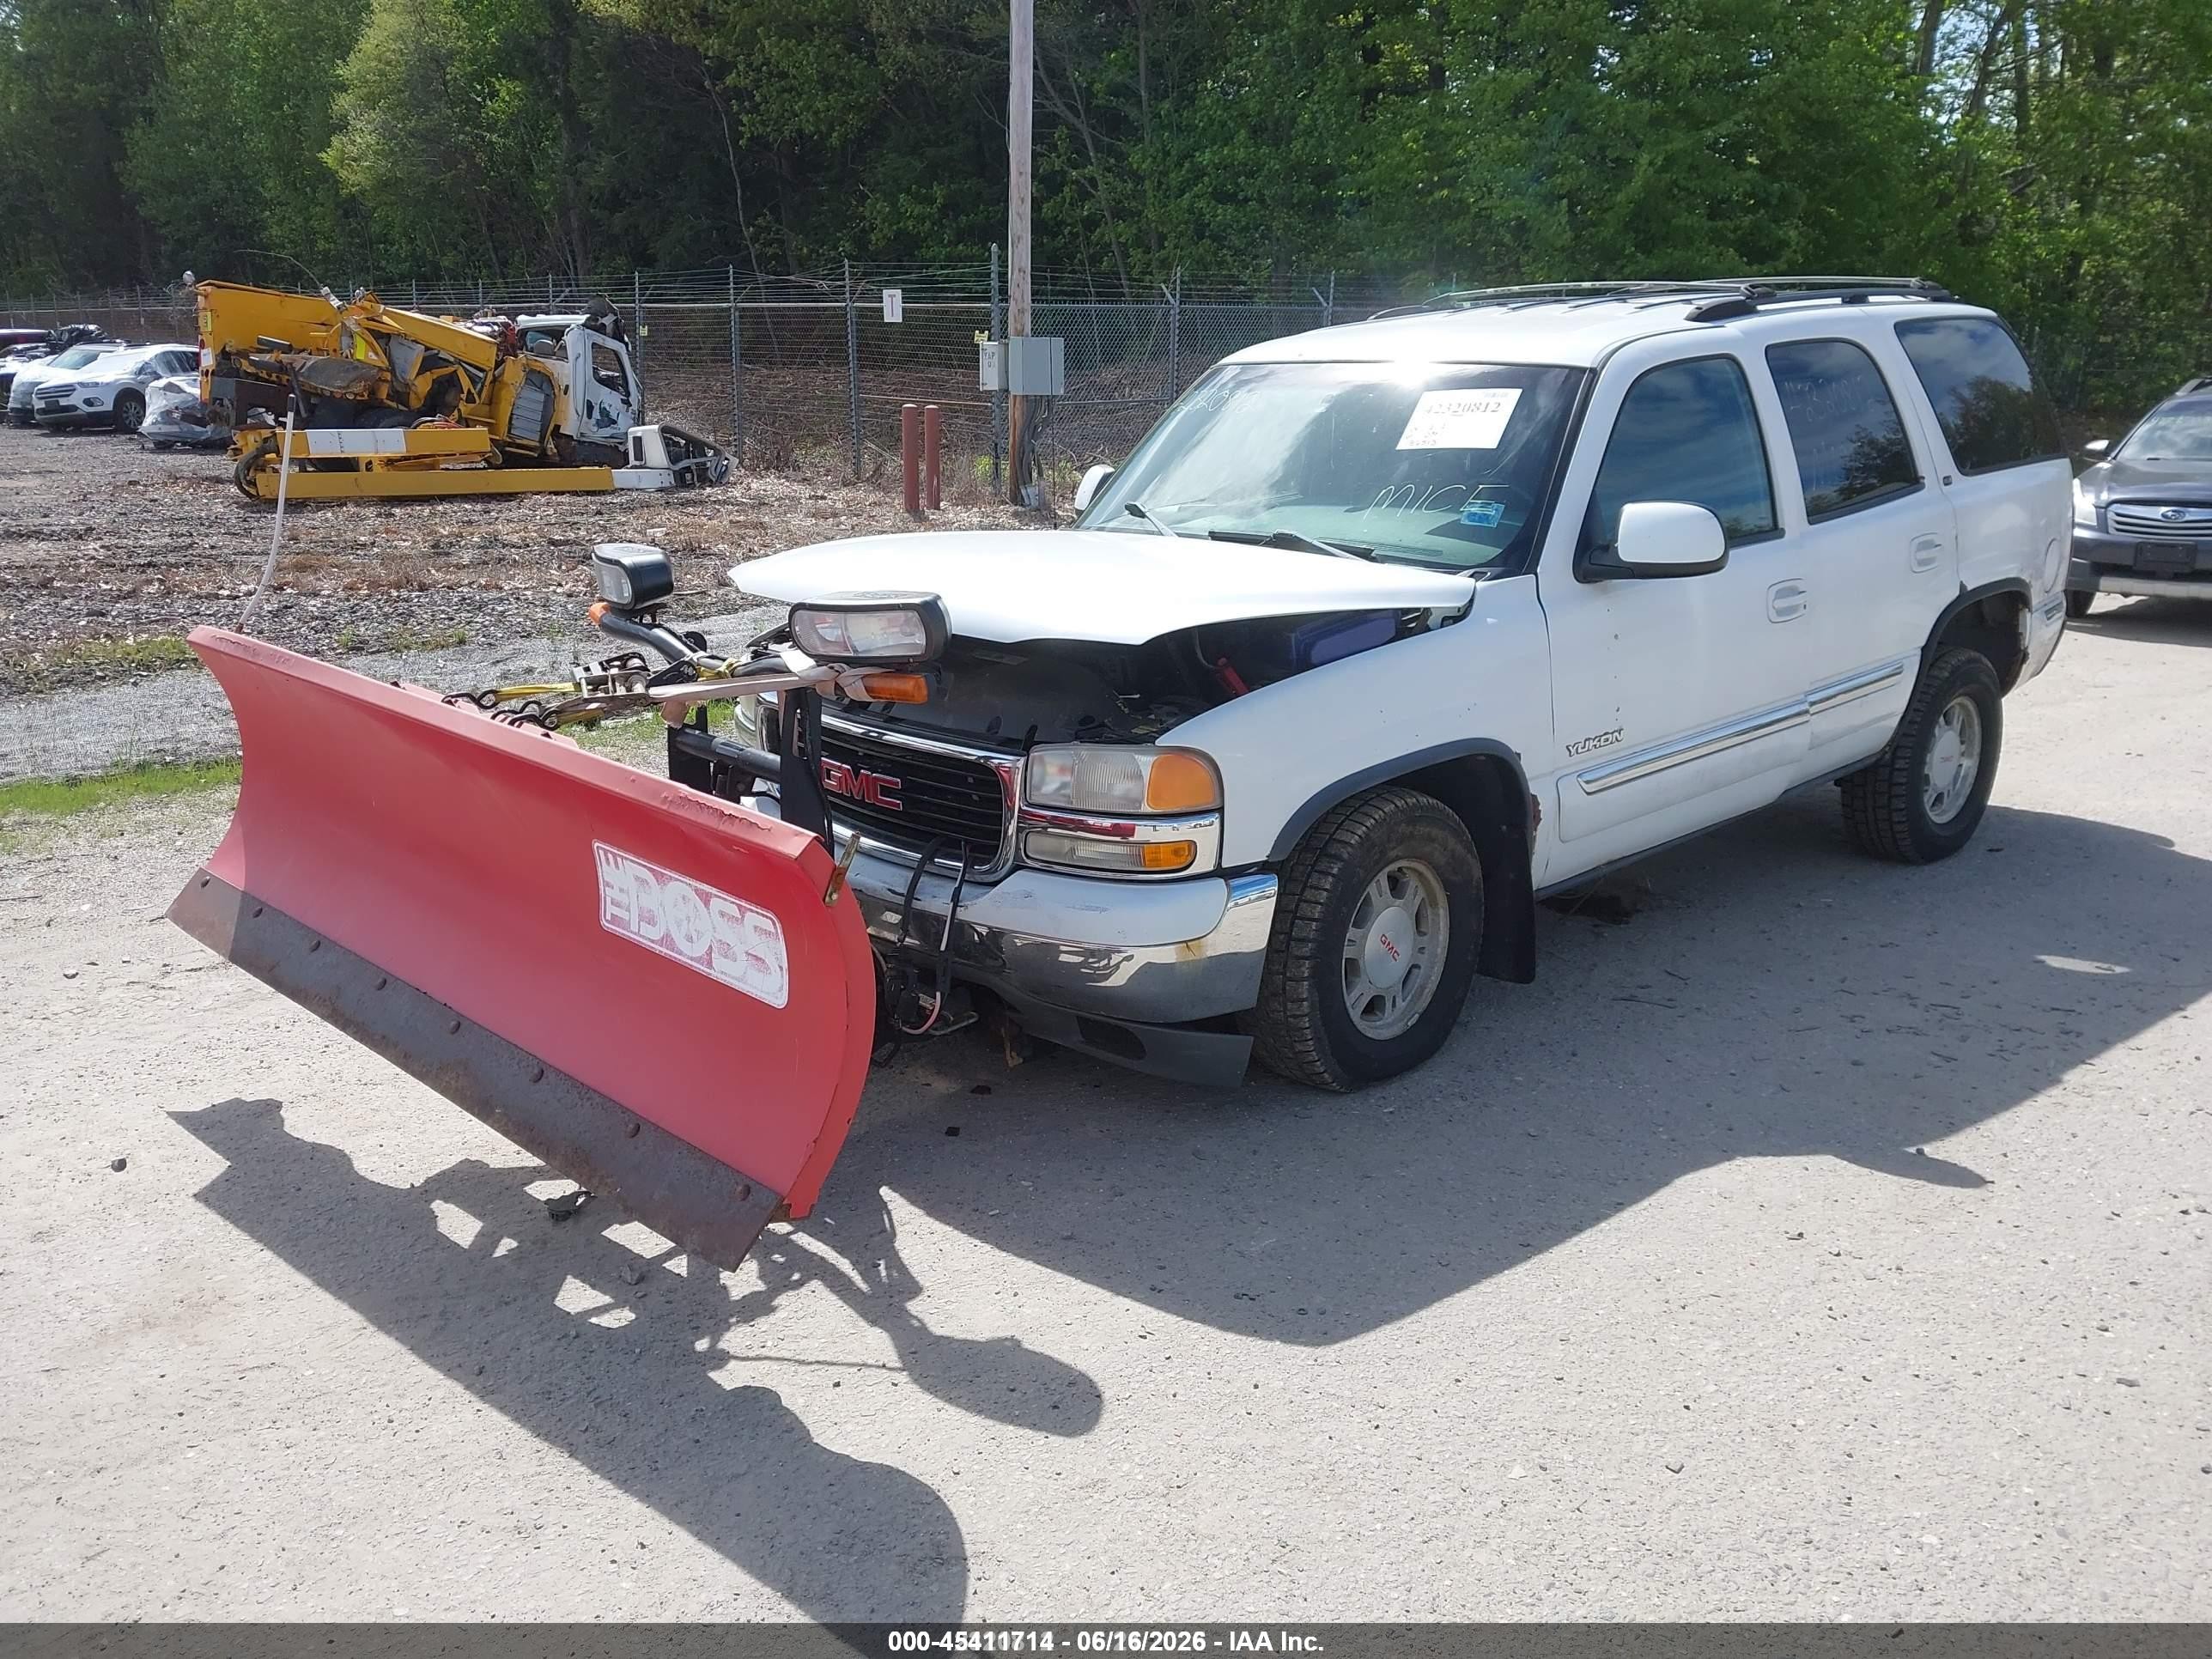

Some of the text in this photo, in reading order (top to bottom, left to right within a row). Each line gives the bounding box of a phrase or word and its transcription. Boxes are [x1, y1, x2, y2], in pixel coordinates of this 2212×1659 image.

[1364, 484, 1510, 520] MICE
[1565, 727, 1625, 757] YUKON
[820, 757, 903, 811] GMC
[625, 860, 782, 994] BOSS
[1379, 933, 1401, 963] GMC
